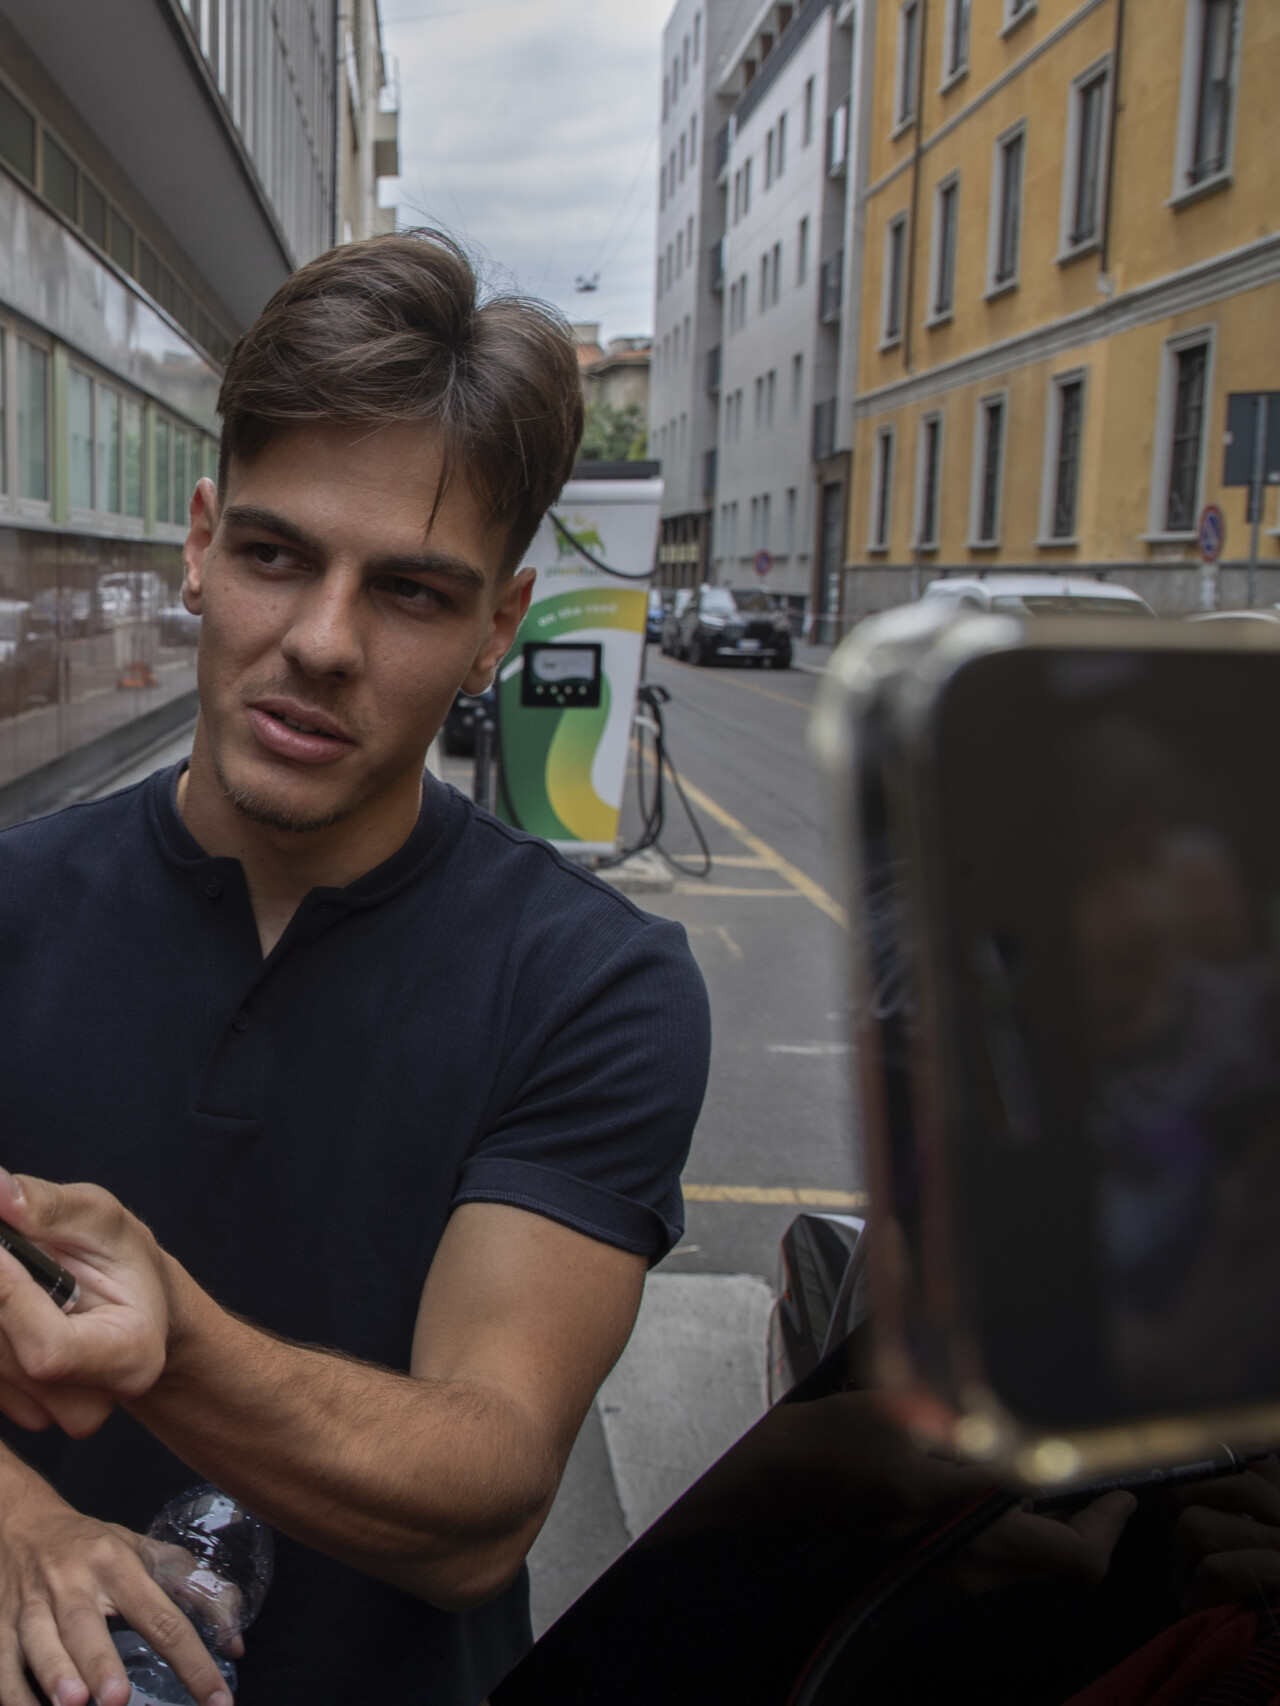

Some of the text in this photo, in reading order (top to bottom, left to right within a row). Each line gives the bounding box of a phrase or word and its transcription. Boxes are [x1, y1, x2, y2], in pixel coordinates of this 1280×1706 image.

[537, 602, 618, 627] on the road
